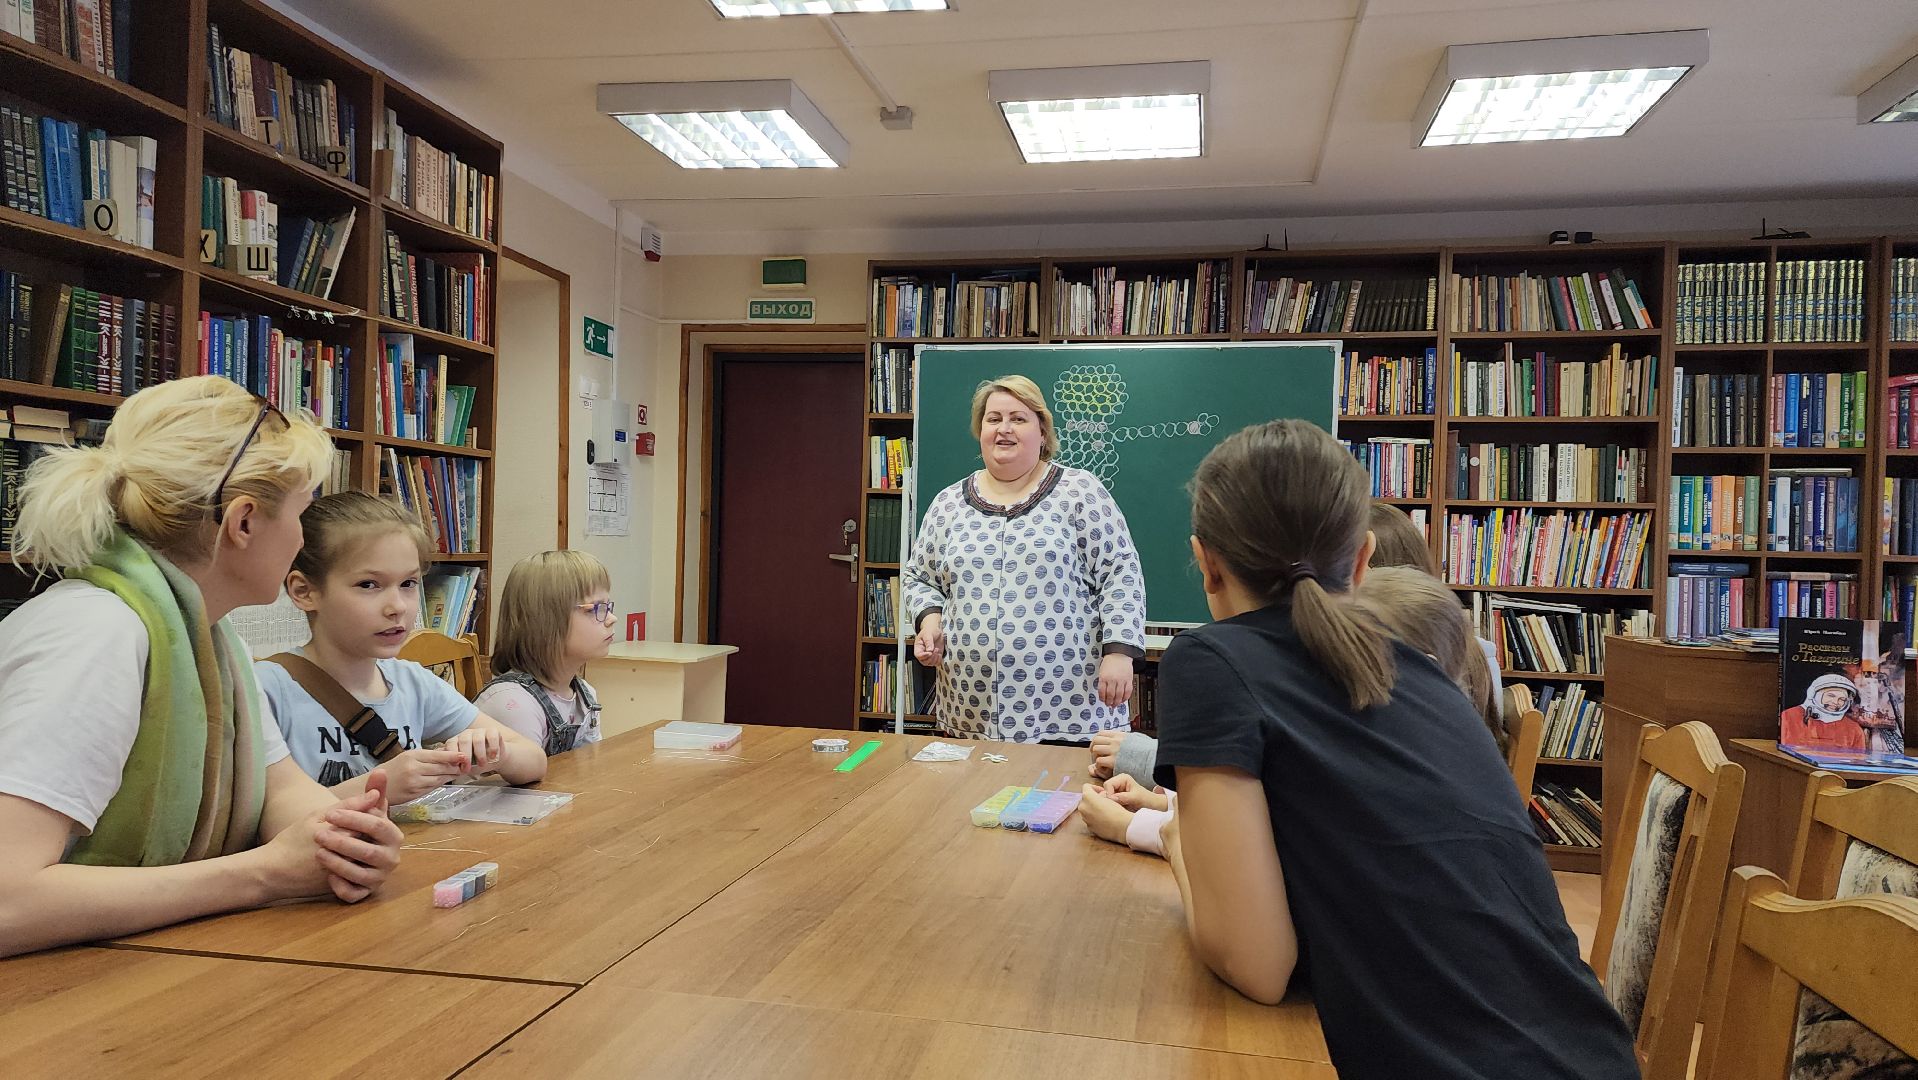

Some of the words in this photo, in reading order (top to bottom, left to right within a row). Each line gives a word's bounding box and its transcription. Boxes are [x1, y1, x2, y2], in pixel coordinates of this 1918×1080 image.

[259, 118, 274, 145] Т
[326, 150, 347, 174] Ф
[93, 204, 114, 231] О
[247, 246, 269, 272] Ш
[751, 304, 811, 317] ВЫХОД
[1791, 654, 1800, 662] о
[1801, 651, 1860, 667] Гагарине
[1798, 642, 1851, 653] Рассказы
